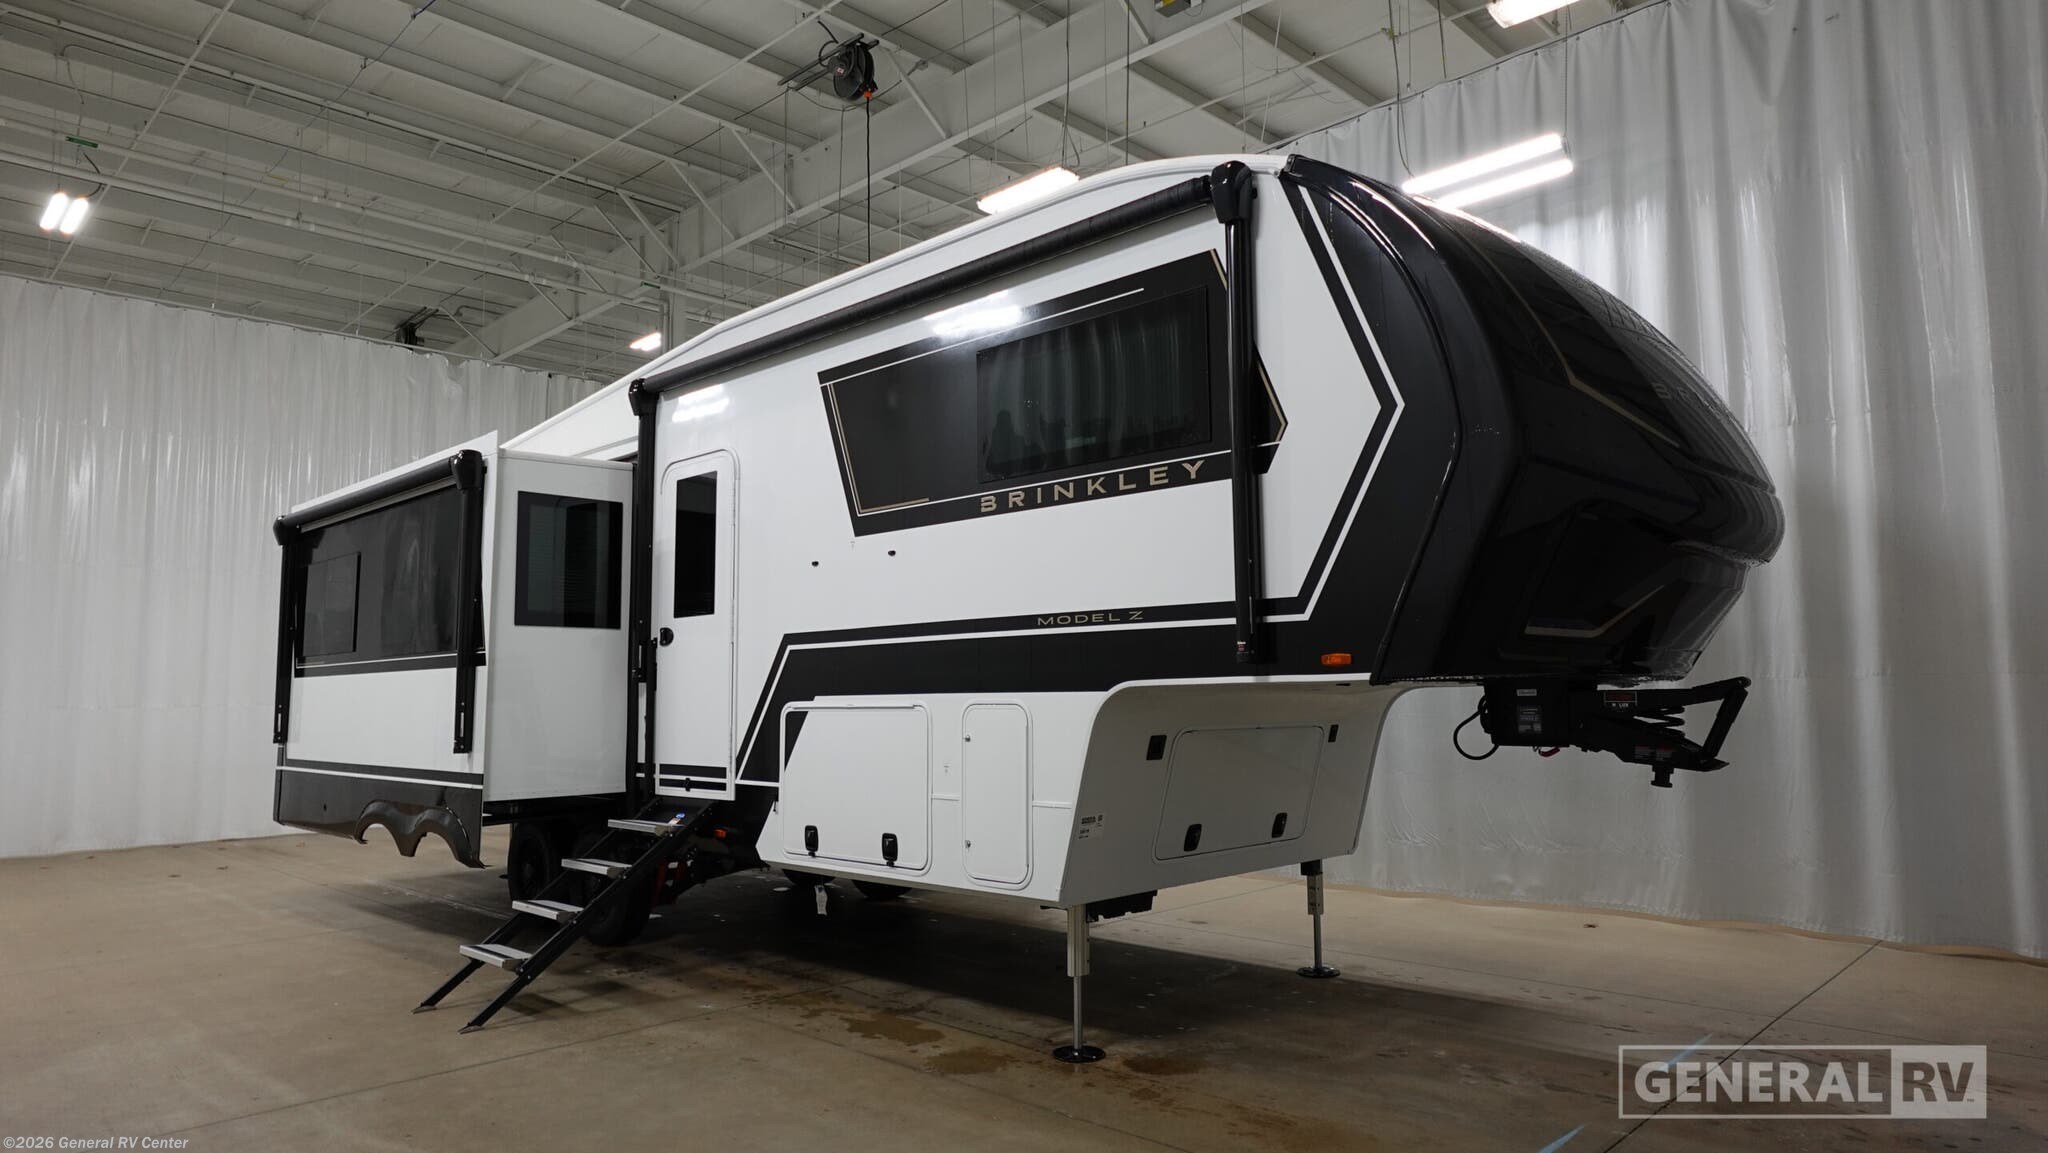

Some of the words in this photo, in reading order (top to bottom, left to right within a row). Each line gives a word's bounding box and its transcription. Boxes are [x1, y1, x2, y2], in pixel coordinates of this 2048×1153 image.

[980, 460, 1205, 512] BRINKLEY
[1037, 612, 1121, 626] MODEL
[1128, 610, 1144, 620] Z
